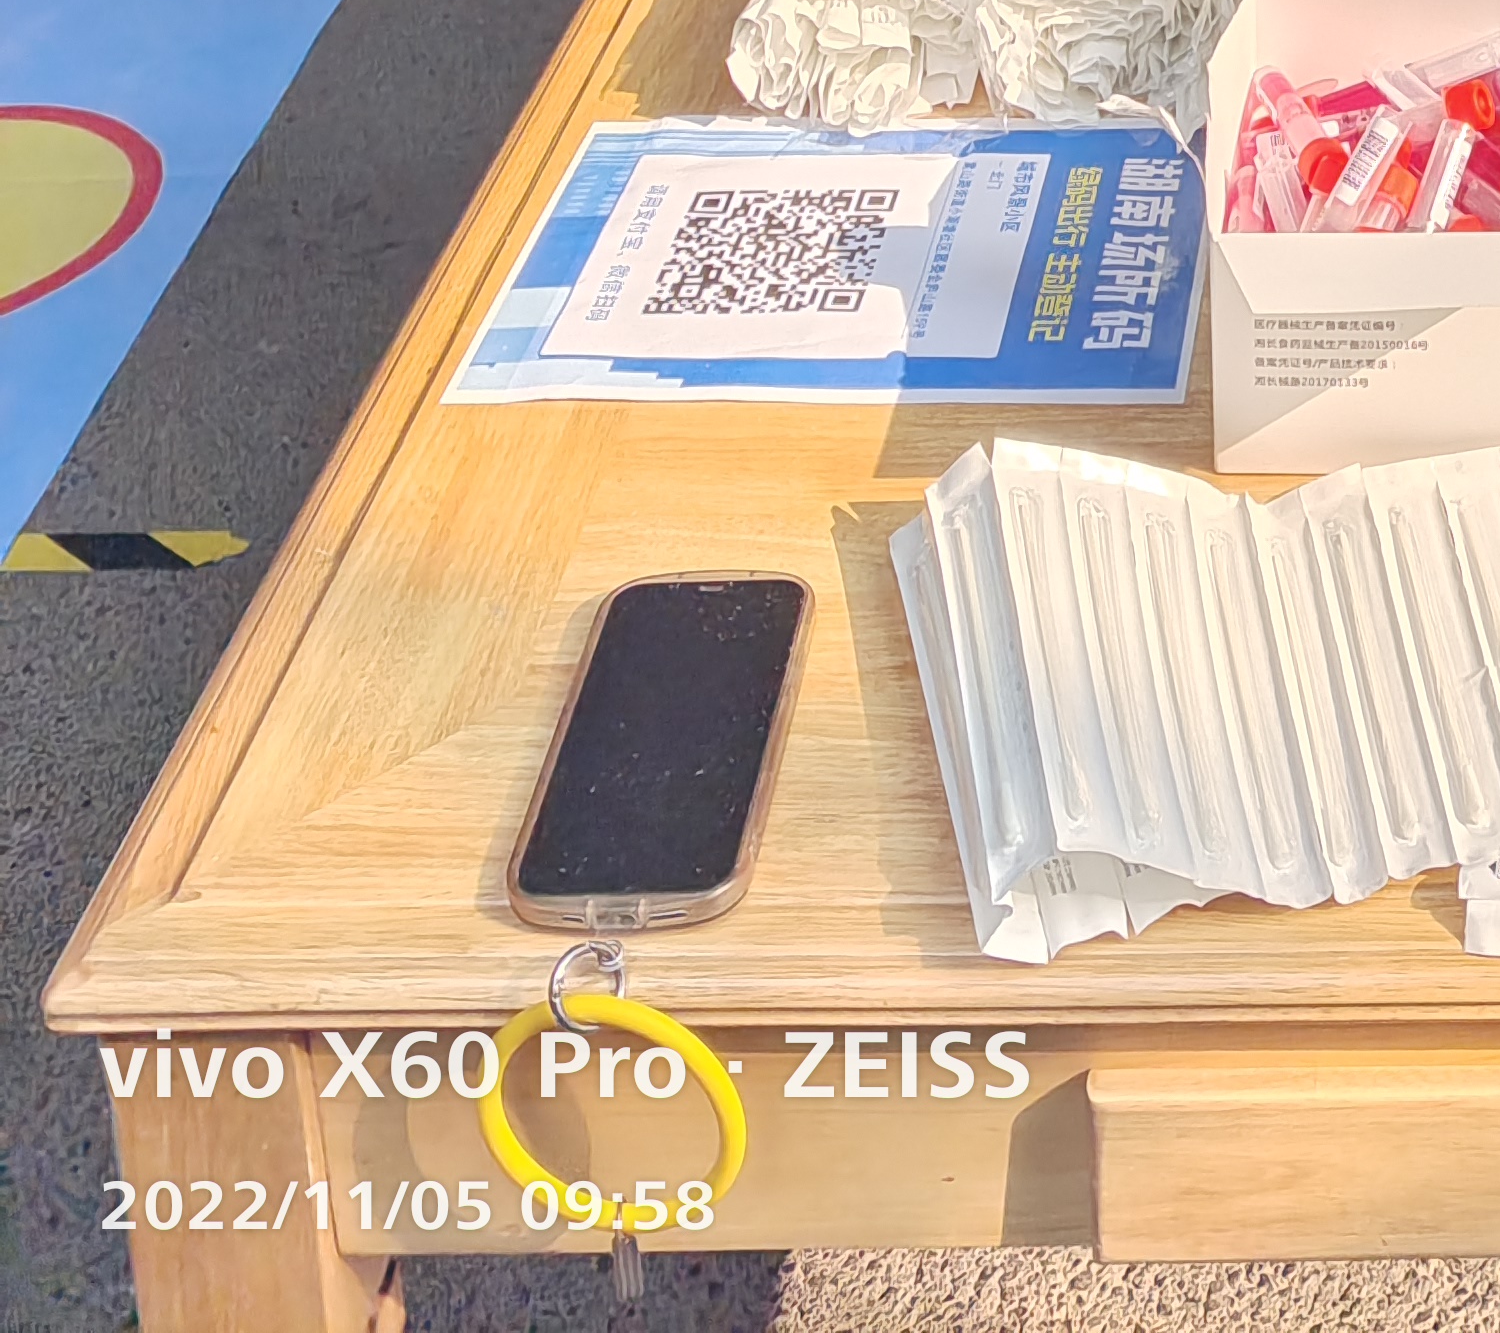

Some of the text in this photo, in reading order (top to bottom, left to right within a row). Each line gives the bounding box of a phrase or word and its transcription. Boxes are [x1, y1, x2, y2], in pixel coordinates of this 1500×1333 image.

[1000, 161, 1038, 233] 城市风景小区
[1028, 166, 1103, 342] 绿码出行 主动登记
[1082, 158, 1184, 350] 湖南场所码
